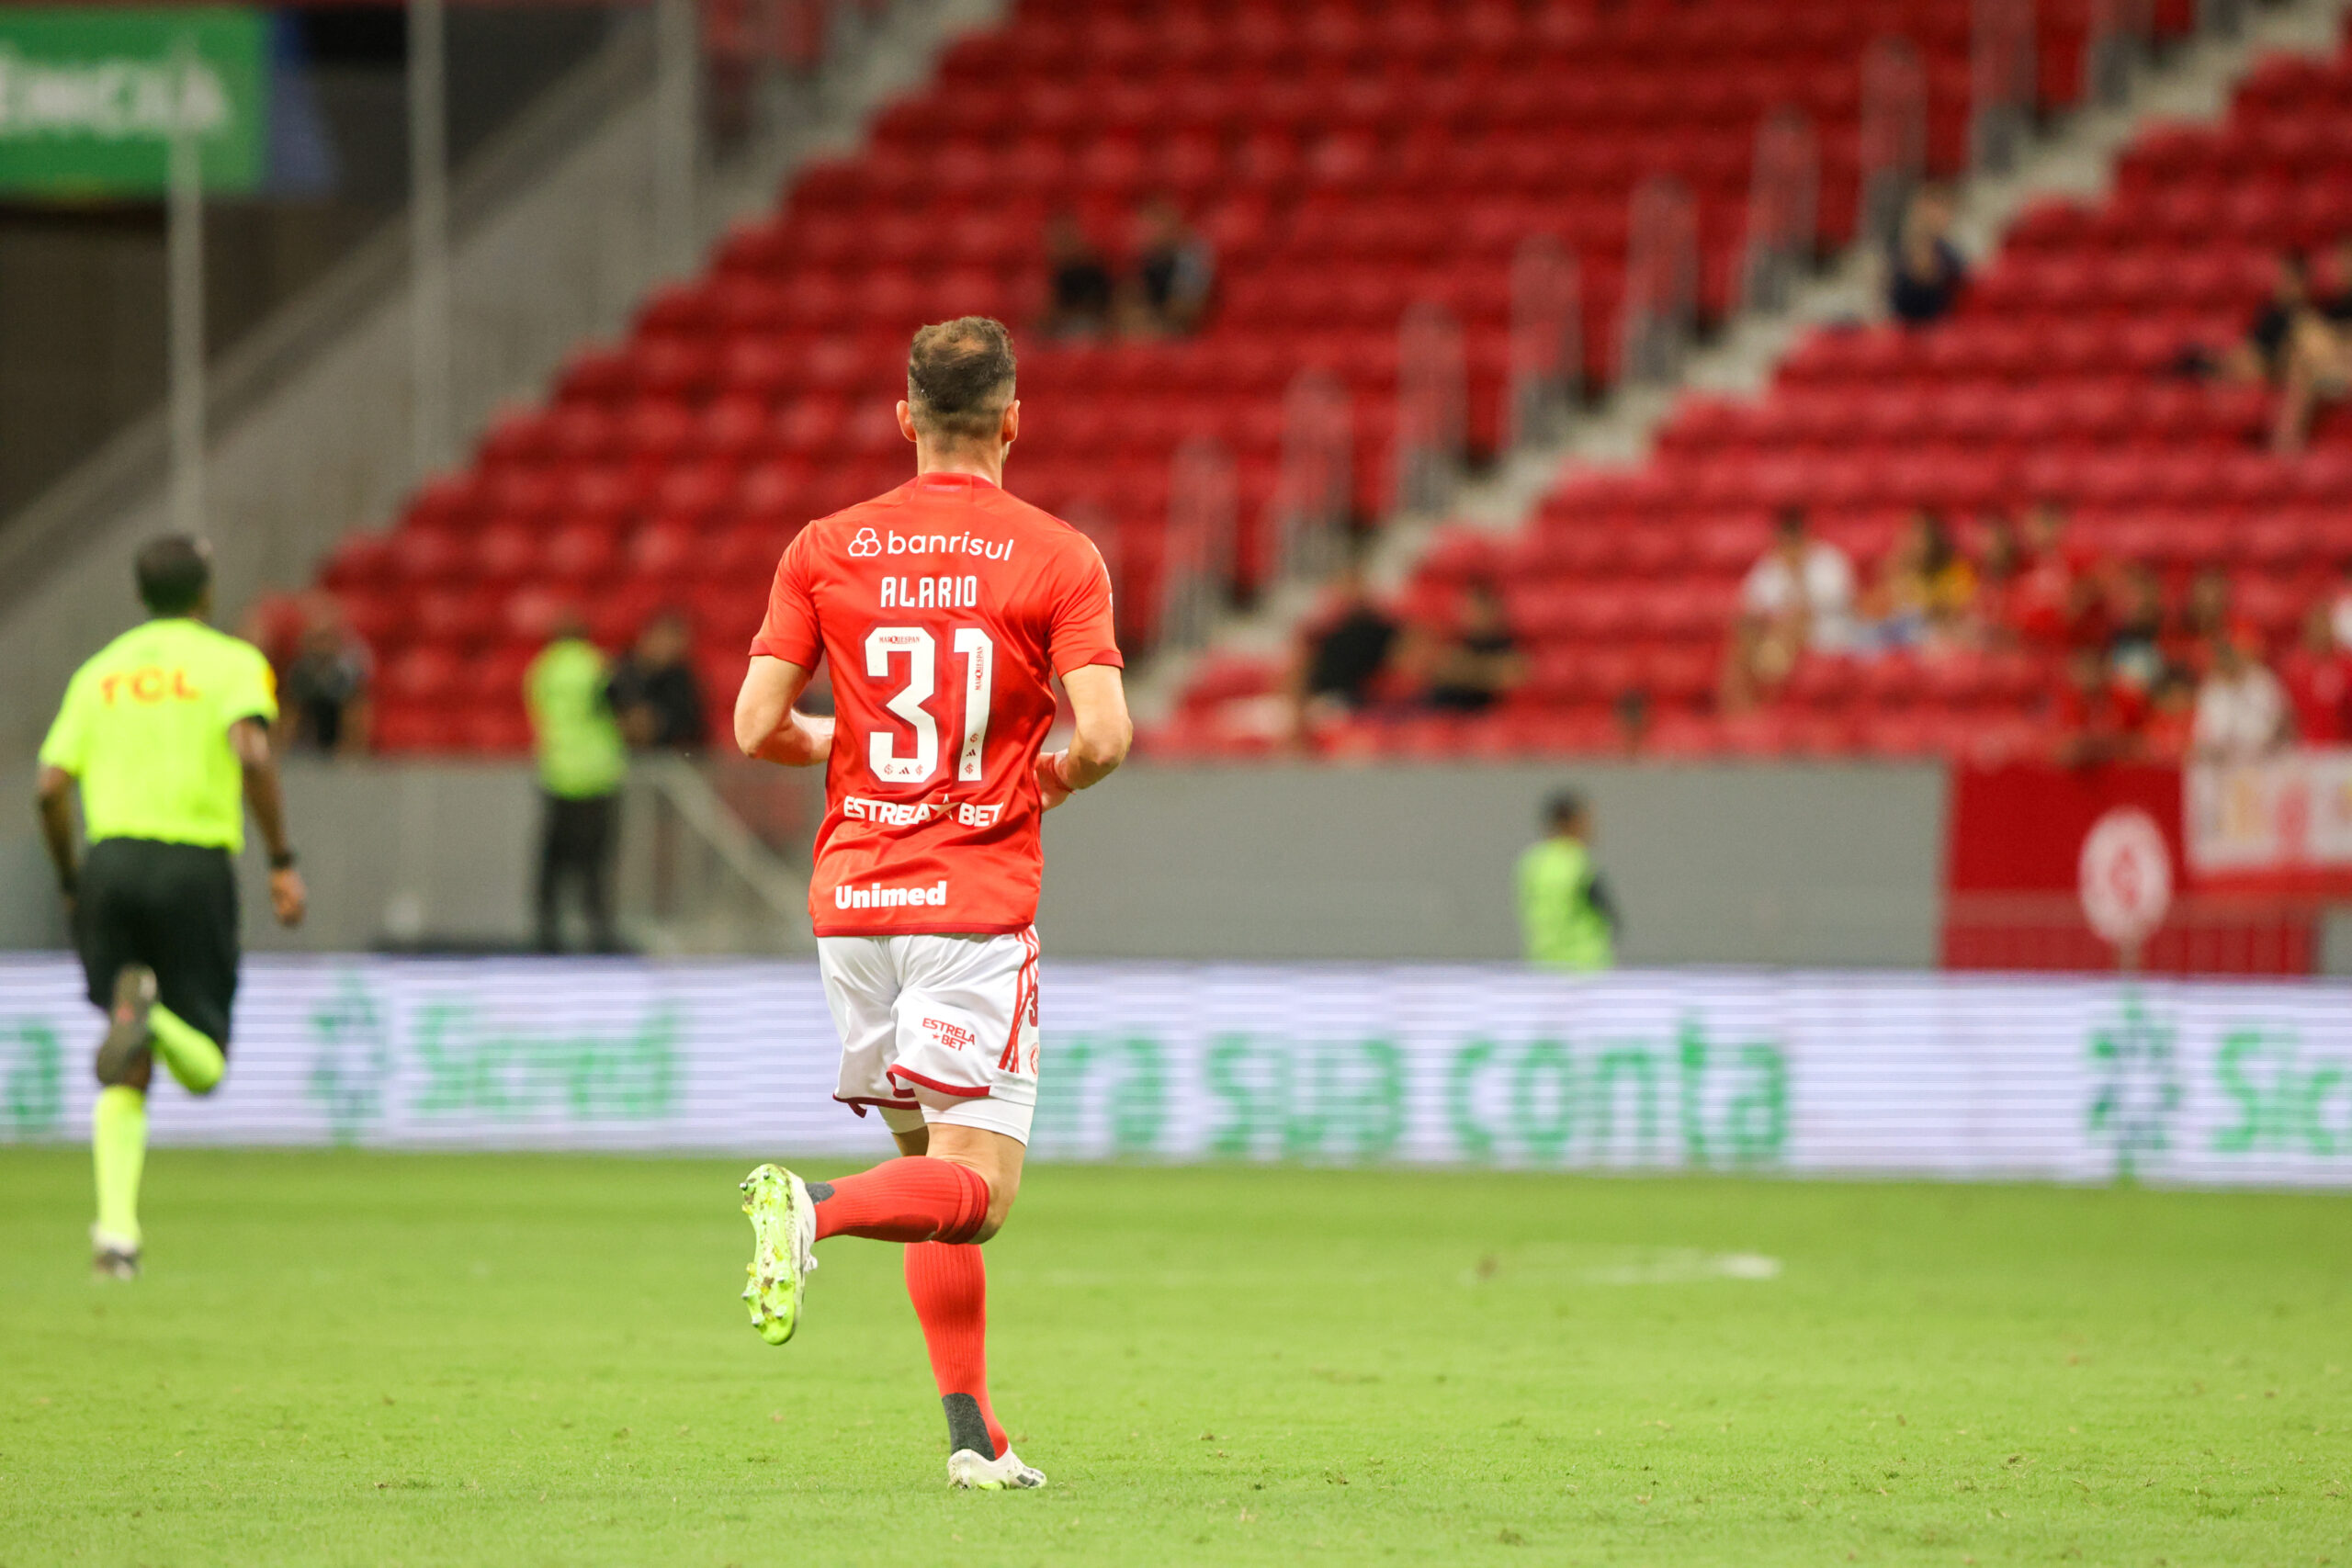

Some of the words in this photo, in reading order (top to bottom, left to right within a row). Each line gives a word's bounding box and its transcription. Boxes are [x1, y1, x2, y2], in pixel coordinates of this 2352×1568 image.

[887, 529, 1014, 561] banrisul
[880, 575, 978, 608] ALARIO
[864, 626, 993, 784] 31
[843, 795, 932, 827] ESTRELA
[958, 801, 1004, 828] BET
[834, 880, 947, 909] Unimed
[922, 1017, 976, 1045] ESTRELA
[941, 1033, 967, 1051] BET
[1445, 1012, 1792, 1163] conta
